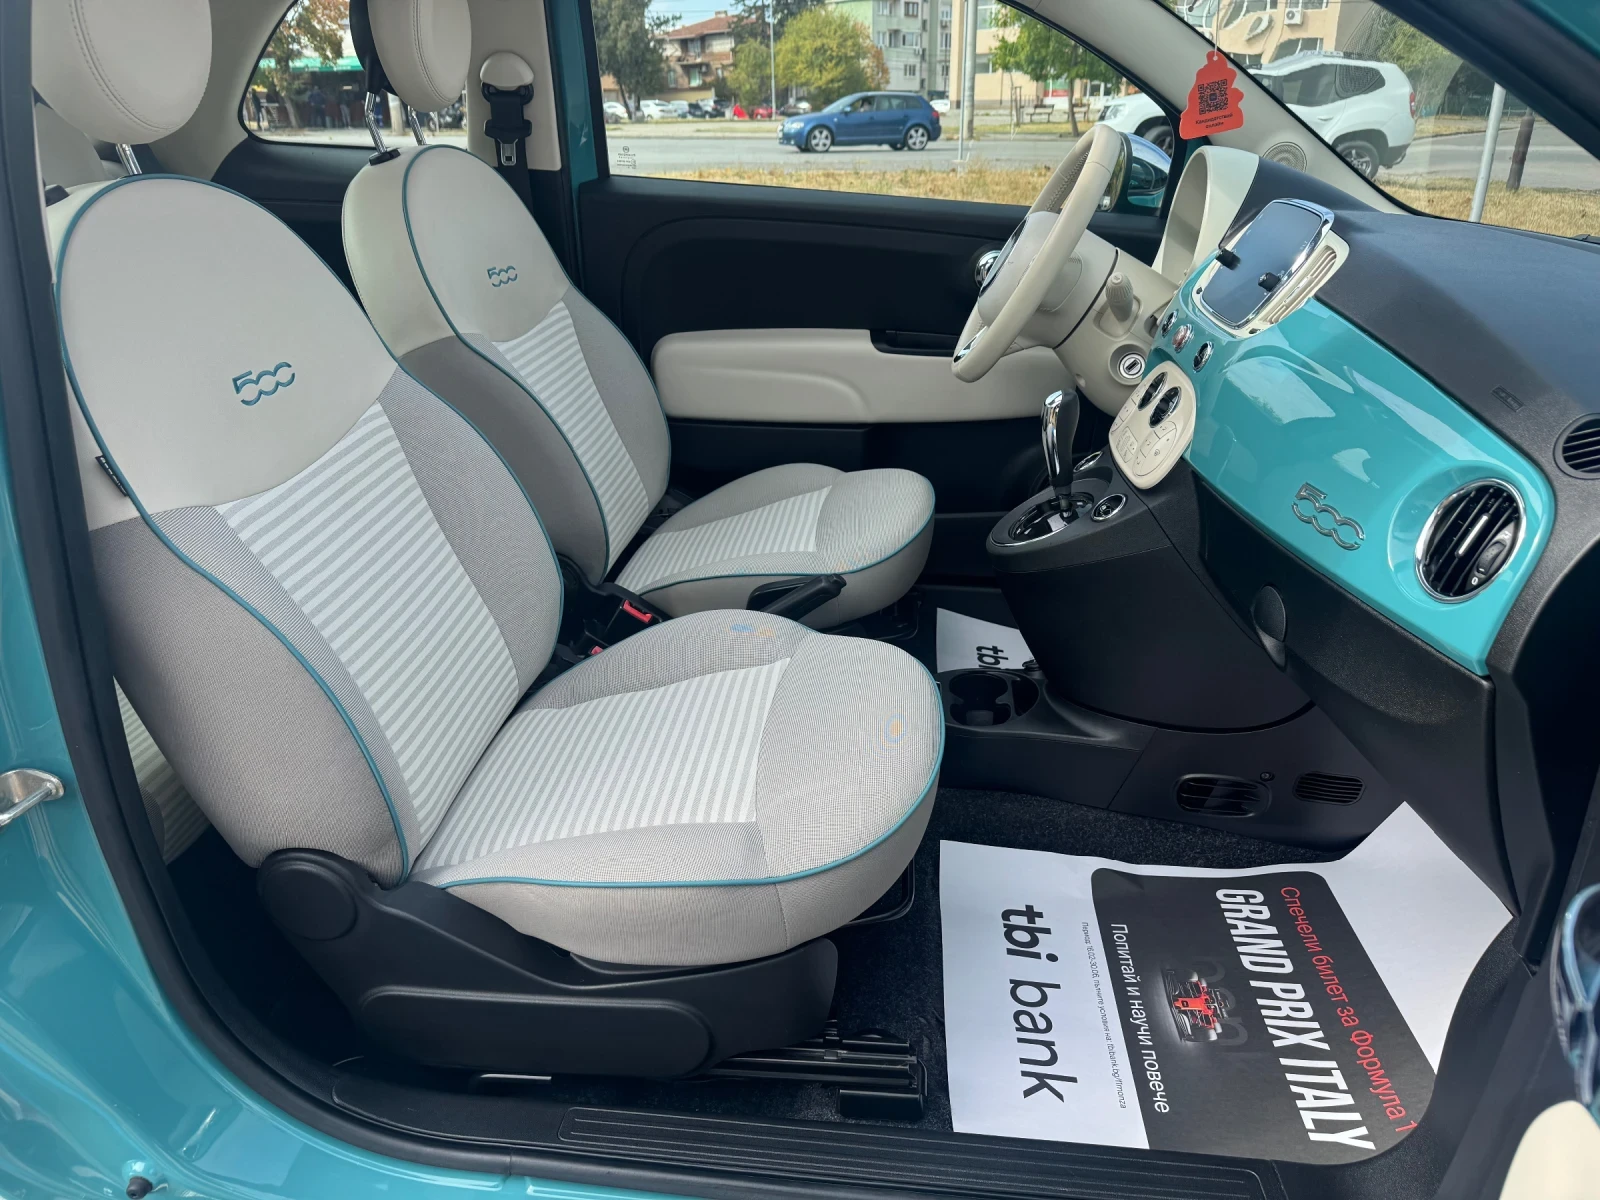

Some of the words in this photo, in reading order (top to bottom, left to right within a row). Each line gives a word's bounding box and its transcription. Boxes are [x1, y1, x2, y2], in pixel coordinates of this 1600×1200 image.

[487, 265, 518, 288] 500
[232, 361, 296, 407] 500
[1291, 481, 1366, 551] 500
[1001, 904, 1059, 963] tbi
[1111, 923, 1142, 983] Попитай
[1215, 889, 1294, 974] GRAND
[1097, 1005, 1110, 1032] условия
[1126, 986, 1141, 996] и
[1249, 980, 1331, 1051] PRIX
[1281, 886, 1323, 953] Спечели
[1312, 954, 1349, 1004] билет
[1336, 1006, 1359, 1027] за
[1350, 1029, 1406, 1120] Формула
[1395, 1120, 1418, 1133] 1
[1009, 978, 1078, 1103] bank
[1129, 1000, 1154, 1045] научи
[1141, 1050, 1170, 1113] повече
[1278, 1057, 1377, 1151] ITALY
